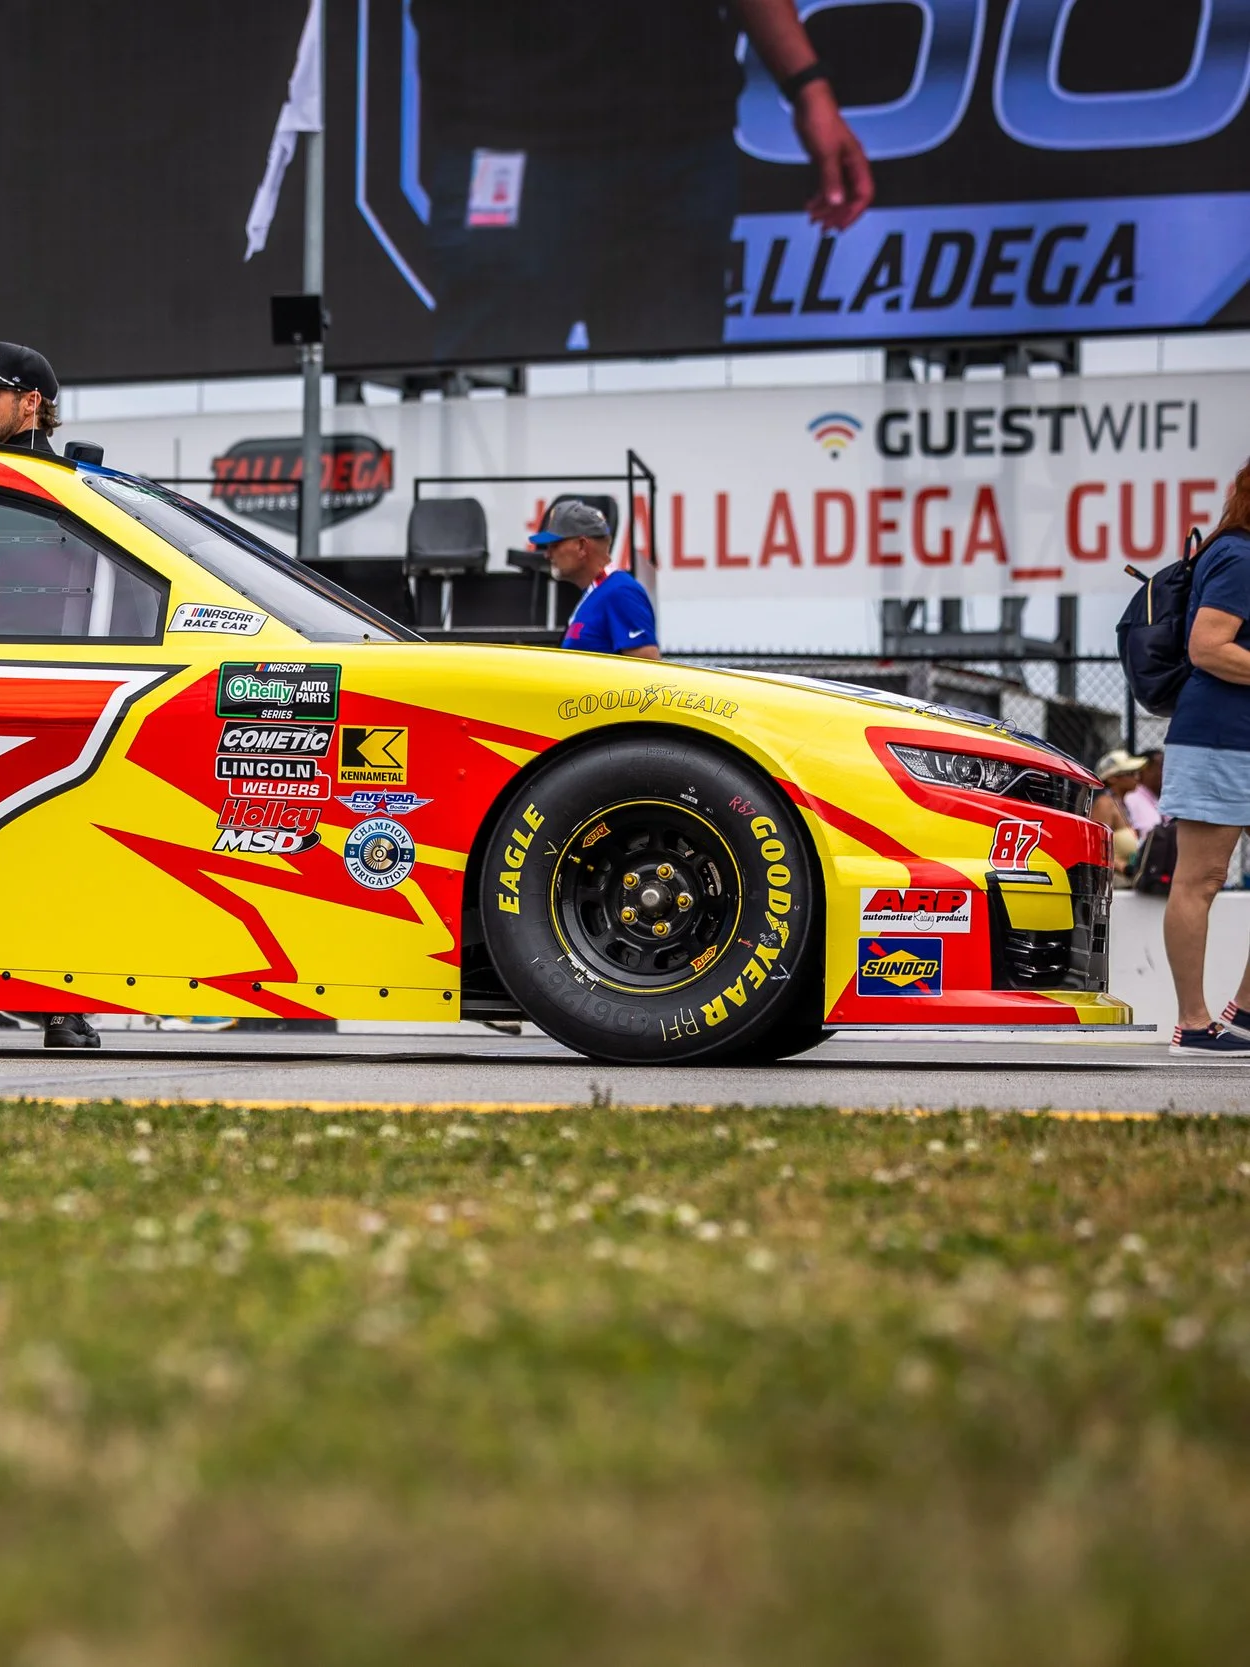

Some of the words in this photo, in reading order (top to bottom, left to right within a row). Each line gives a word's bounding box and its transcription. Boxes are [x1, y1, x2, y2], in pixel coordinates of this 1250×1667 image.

[202, 608, 254, 623] NASCAR
[183, 620, 218, 628] RACE
[221, 621, 248, 631] CAR
[267, 663, 306, 673] NASCAR
[228, 676, 294, 703] O'Reilly
[299, 681, 329, 692] AUTO
[295, 692, 331, 703] PARTS
[260, 709, 293, 719] SERIES
[222, 729, 329, 751] COMETIC
[221, 761, 311, 778] LINCOLN
[340, 770, 403, 782] KENNAMETAL
[242, 781, 320, 796] WELDERS
[352, 792, 383, 803] FIVE
[386, 793, 415, 804] STAR
[217, 799, 322, 838] Holley
[213, 829, 304, 854] MSD
[353, 821, 408, 845] CHAMPION
[586, 826, 604, 844] AERO
[989, 819, 1043, 870] 87
[498, 803, 545, 914] EAGLE
[350, 860, 407, 886] IRRIGATION
[863, 889, 968, 913] ARP
[862, 913, 913, 922] automotive
[936, 913, 969, 923] products
[696, 950, 714, 968] AERO
[864, 961, 937, 976] SUNOCO
